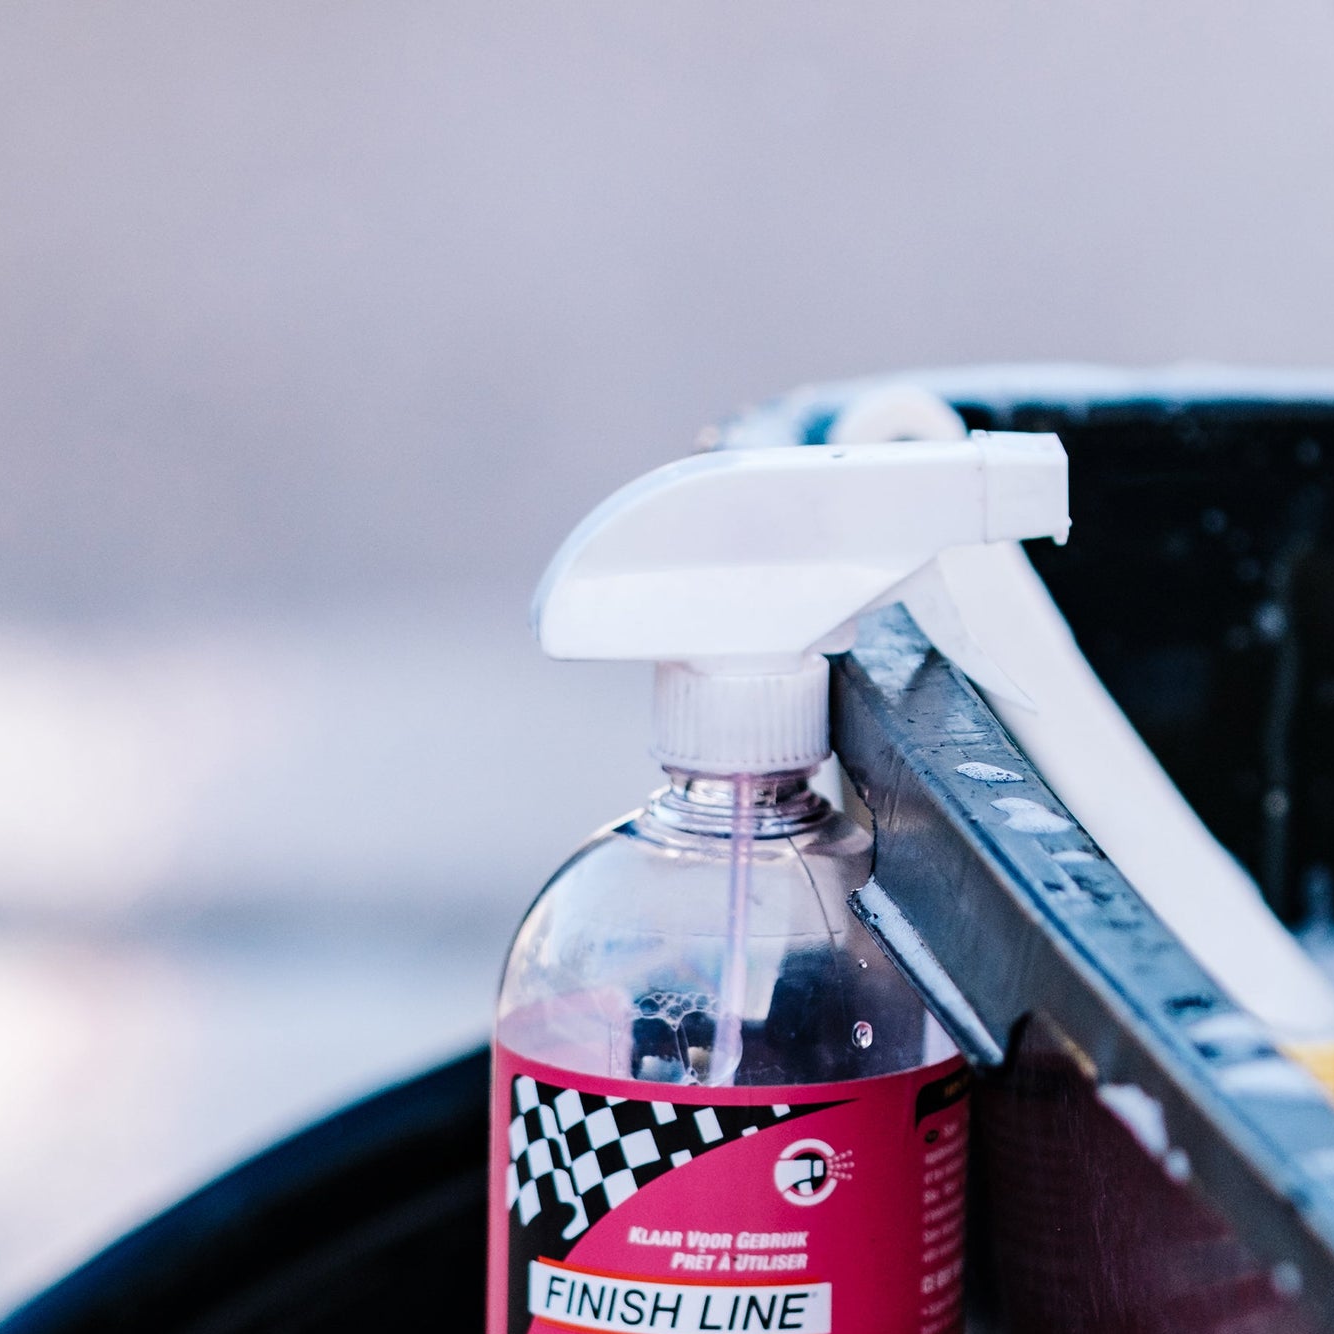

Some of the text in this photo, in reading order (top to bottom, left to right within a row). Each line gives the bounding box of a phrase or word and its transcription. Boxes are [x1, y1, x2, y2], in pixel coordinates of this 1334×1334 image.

[628, 1226, 809, 1249] KLAAR VOOR GEBRUIK
[735, 1253, 808, 1271] UTILISER
[545, 1276, 682, 1329] FINISH
